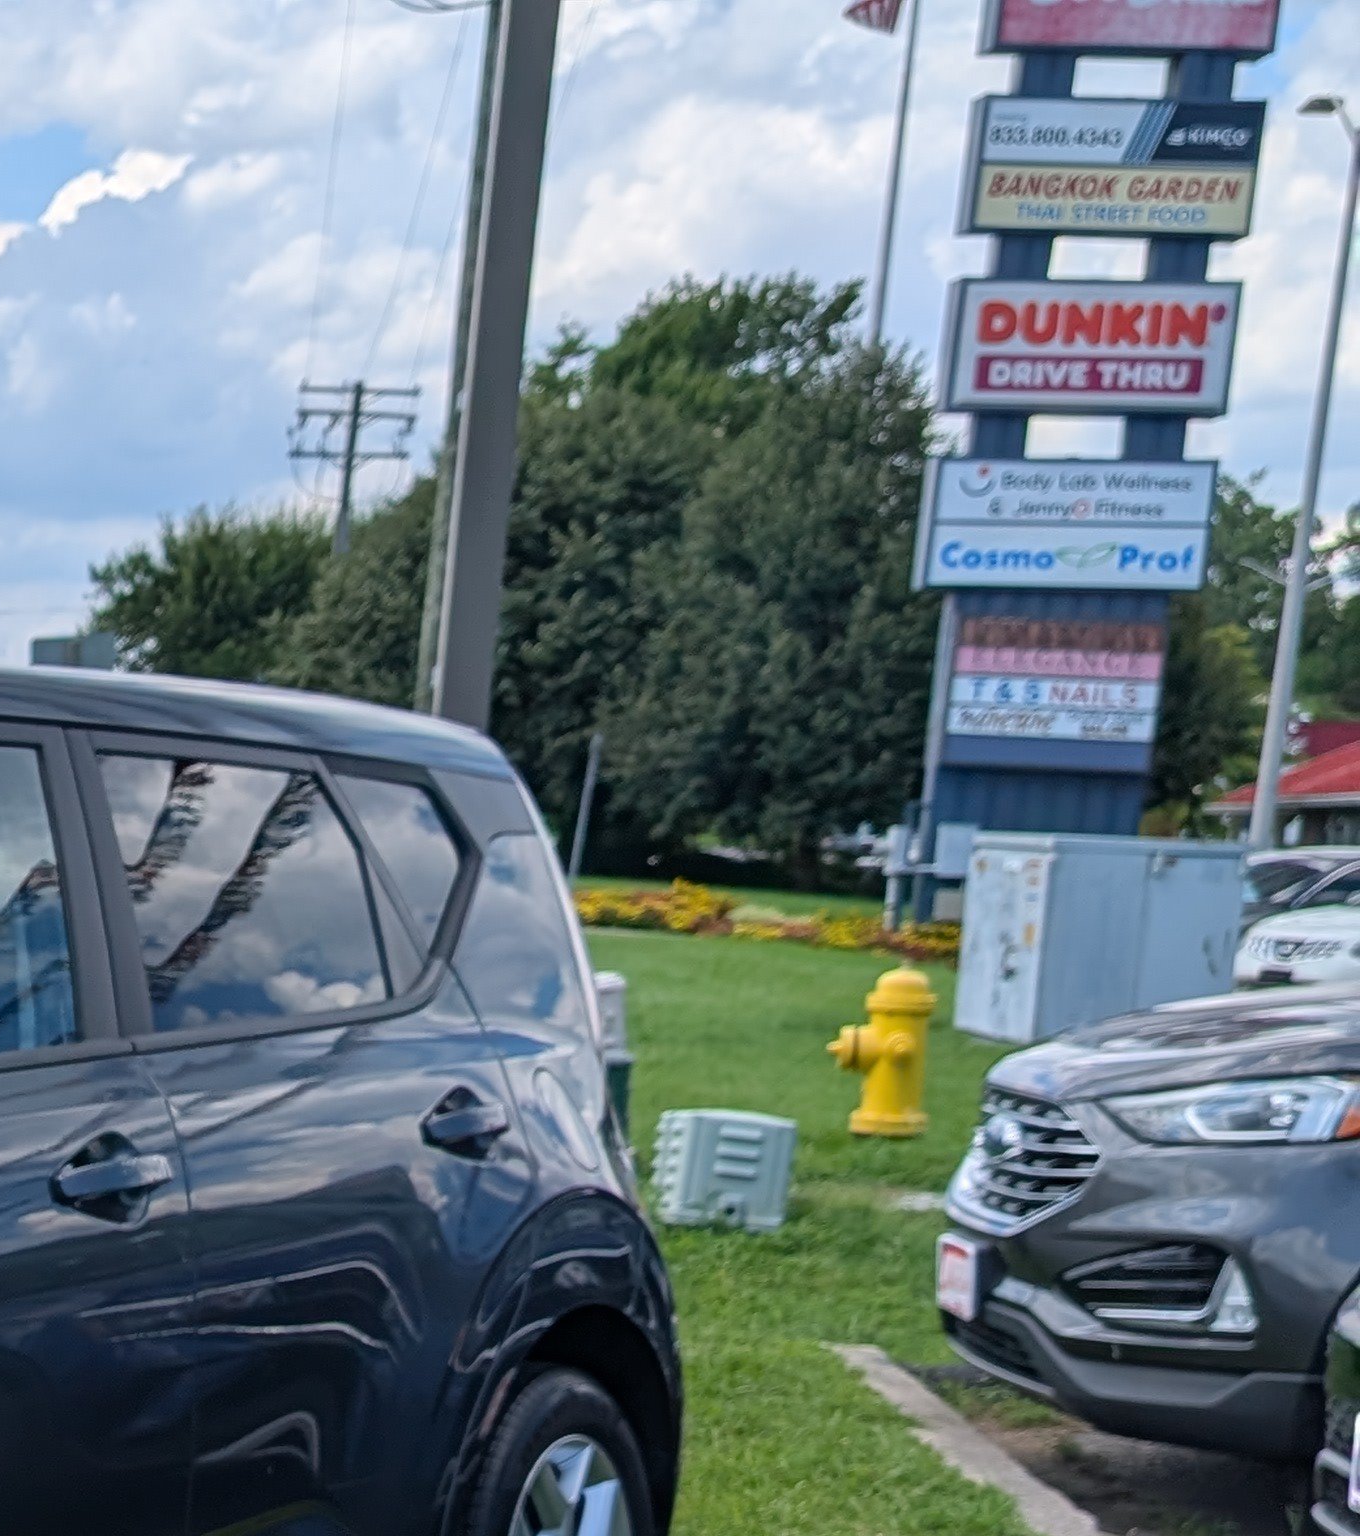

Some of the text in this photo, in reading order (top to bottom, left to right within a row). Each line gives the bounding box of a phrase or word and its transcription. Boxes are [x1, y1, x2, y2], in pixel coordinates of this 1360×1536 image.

[987, 172, 1243, 203] BANGKOK GARDEN
[1017, 203, 1206, 226] THAI STREET FOOD
[977, 302, 1226, 347] DUNKIN'
[987, 359, 1191, 389] DRIVE THRU
[1000, 470, 1053, 494] Body
[1058, 470, 1099, 491] Lab
[1094, 499, 1165, 517] Fitness
[940, 540, 1195, 571] Cosmo Prof
[1048, 683, 1138, 708] NAILS
